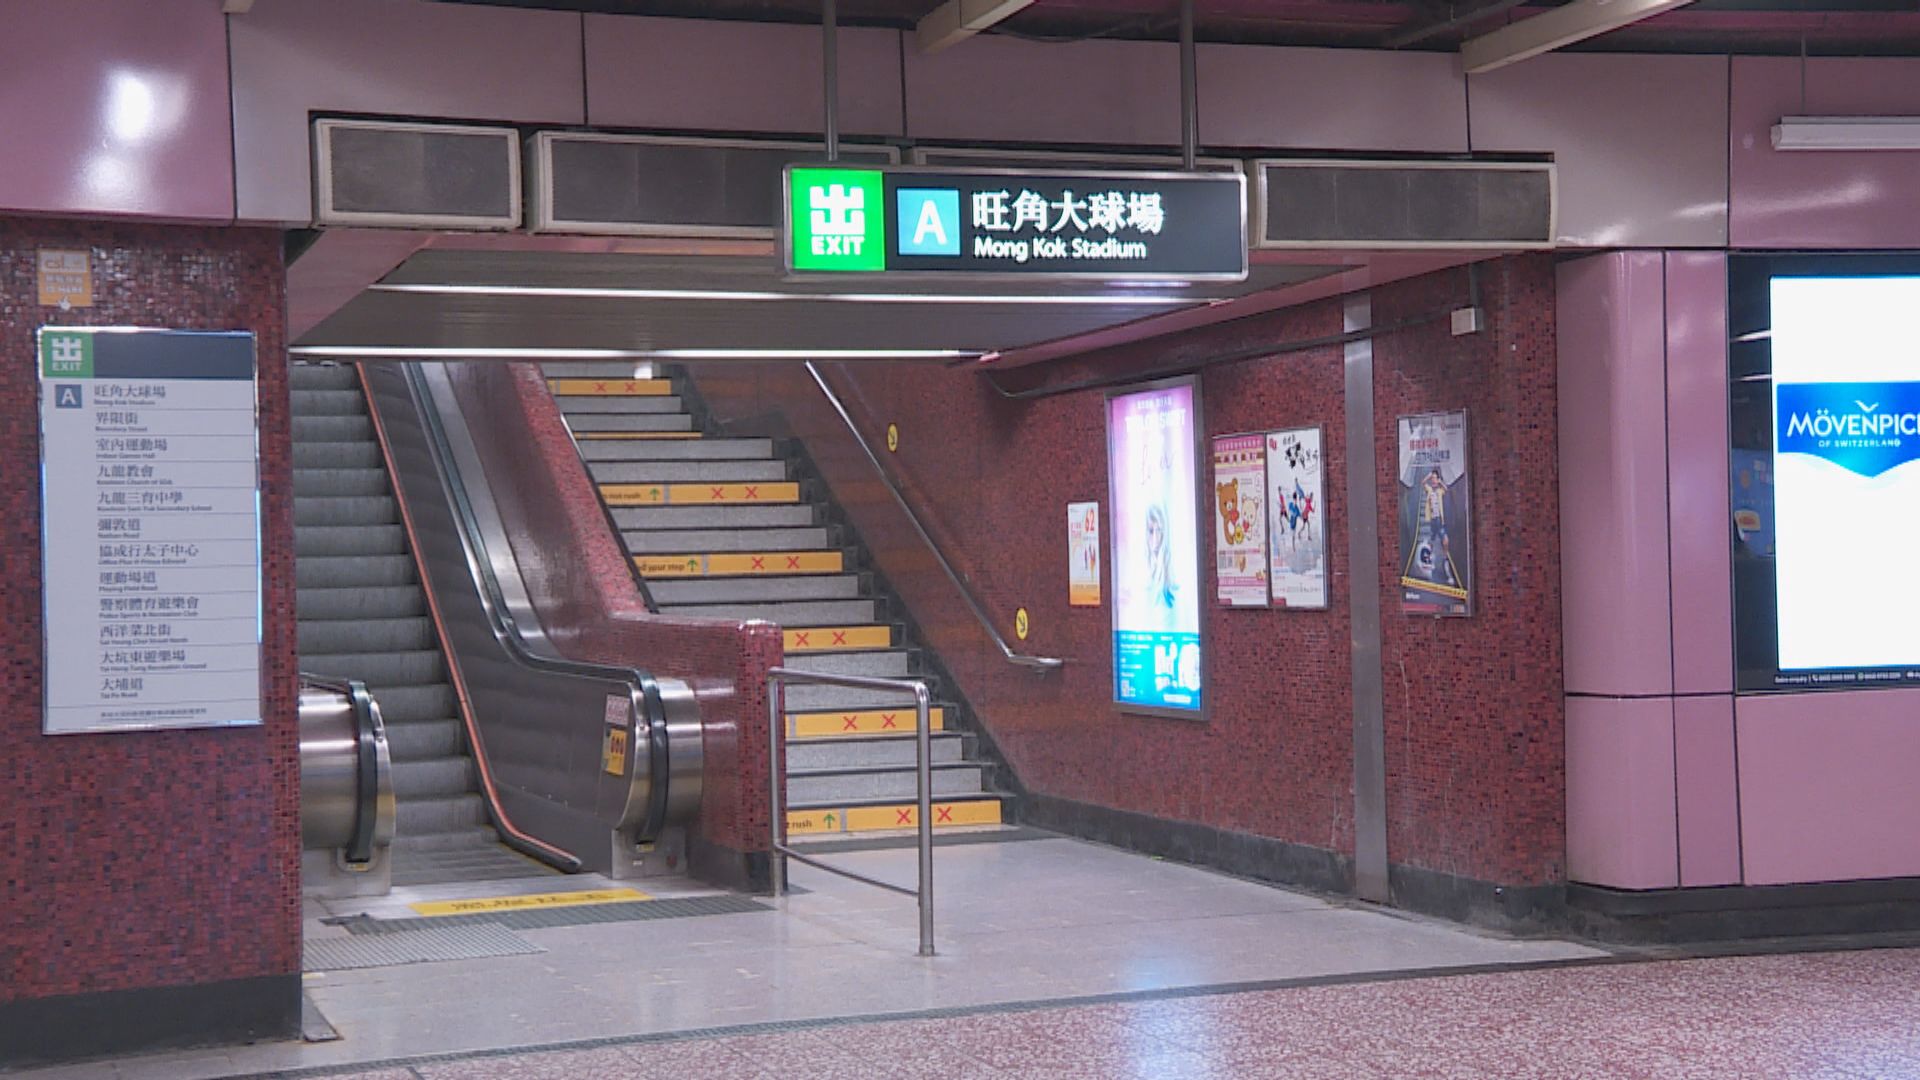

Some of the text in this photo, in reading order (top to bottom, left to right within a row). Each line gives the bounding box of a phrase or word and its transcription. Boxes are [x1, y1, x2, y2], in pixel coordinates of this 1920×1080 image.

[971, 189, 1164, 234] 旺角大球場
[912, 200, 946, 245] A
[811, 236, 865, 255] EXIT
[974, 237, 1147, 262] Mong Kok Stadium
[51, 362, 82, 372] EXIT
[61, 388, 76, 405] A
[94, 384, 166, 398] 旺角大球場
[1818, 438, 1902, 447] OF SWITZERLAND
[97, 464, 154, 478] 九龍教會
[97, 491, 183, 505] 九龍三育中學
[97, 518, 141, 531] 彌敦道
[101, 677, 143, 690] 大埔道
[792, 819, 812, 829] rush
